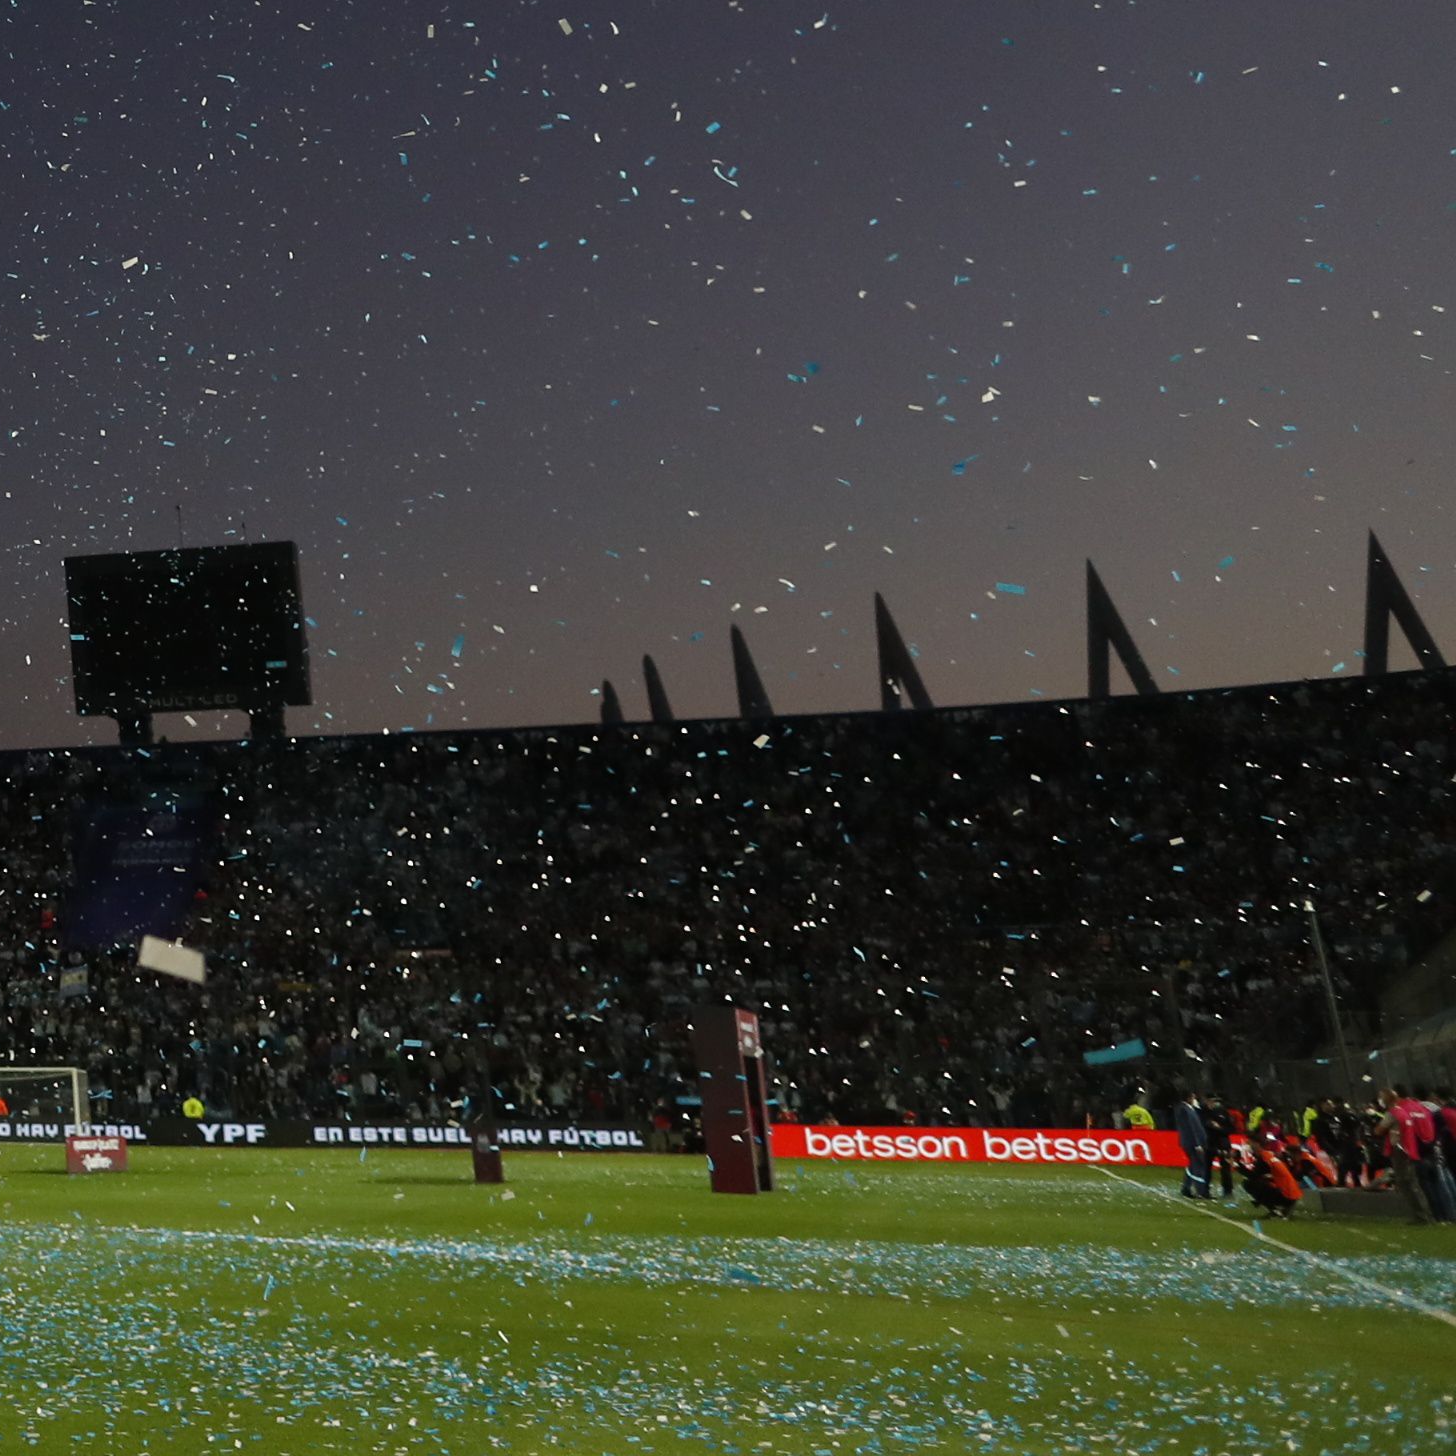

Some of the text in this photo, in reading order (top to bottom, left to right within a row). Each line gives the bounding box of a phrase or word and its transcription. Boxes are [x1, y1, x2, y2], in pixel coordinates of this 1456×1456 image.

[15, 1123, 58, 1137] HAY
[198, 1124, 265, 1143] YPF
[314, 1127, 343, 1141] EN
[349, 1127, 406, 1142] ESTE
[413, 1128, 472, 1143] SUEL
[549, 1127, 643, 1146] FÚTBOL
[804, 1127, 967, 1159] betsson
[983, 1130, 1152, 1162] betsson
